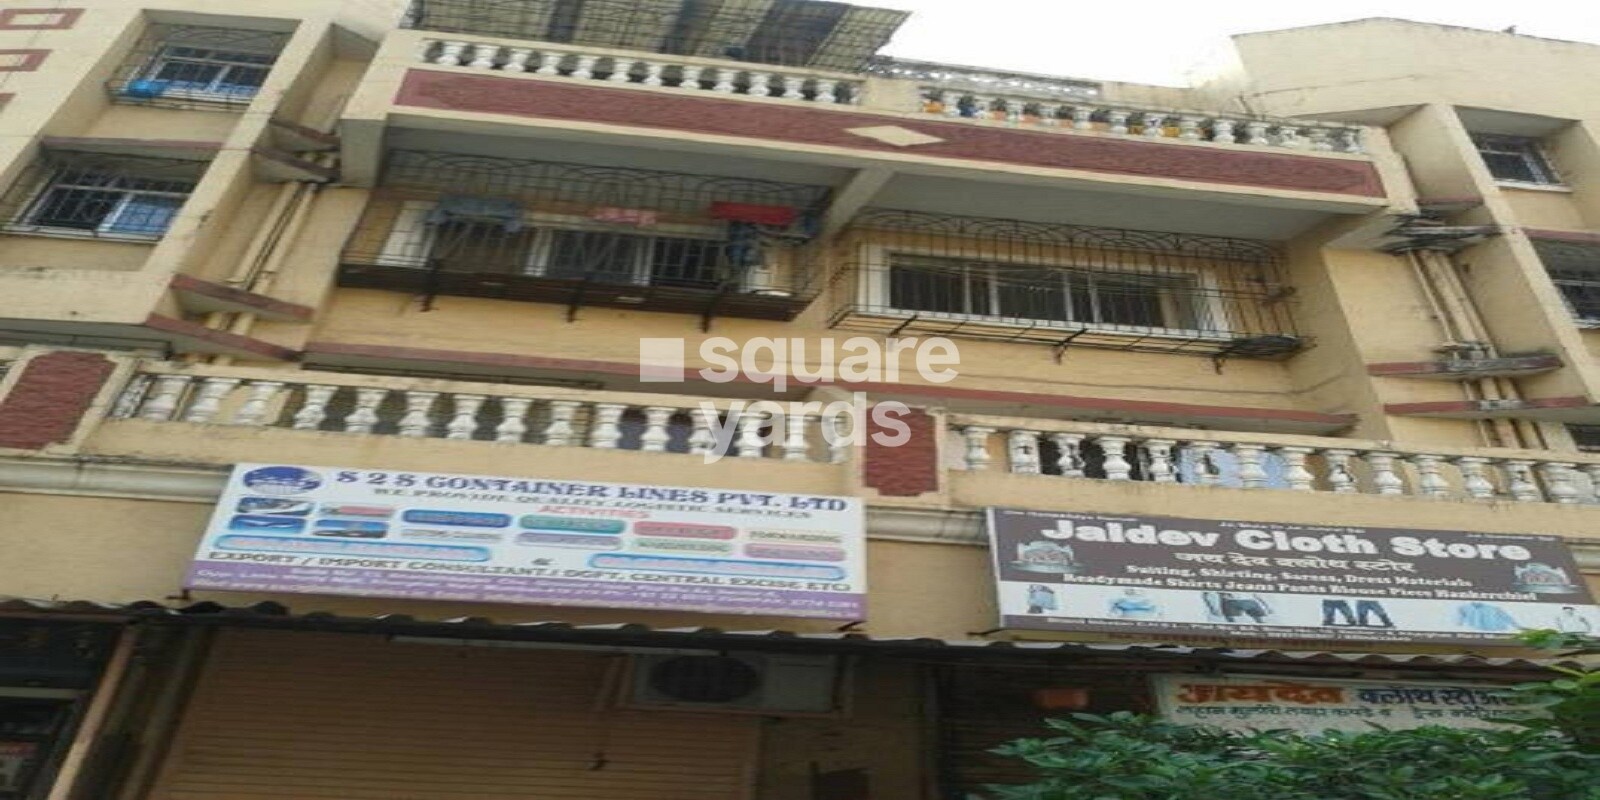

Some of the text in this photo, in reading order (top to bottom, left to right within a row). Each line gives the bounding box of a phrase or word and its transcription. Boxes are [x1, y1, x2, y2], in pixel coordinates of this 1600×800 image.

[413, 490, 505, 503] PROVIDE
[514, 496, 609, 508] QUALITY
[713, 506, 811, 519] SERVICES
[619, 487, 709, 504] LINES
[717, 492, 782, 507] PVT.
[789, 498, 847, 512] LTD
[1041, 520, 1221, 547] Jaldev
[1235, 529, 1379, 555] Cloth
[1389, 536, 1532, 561] Store
[208, 552, 299, 563] EXPORT
[319, 558, 399, 569] IMPORT
[631, 573, 724, 585] CENTRAL
[731, 578, 802, 588] EXCISE
[1062, 573, 1162, 586] Readymade
[1166, 577, 1221, 590] Shirts
[1225, 580, 1274, 592] Jeans
[1344, 575, 1392, 585] Dress
